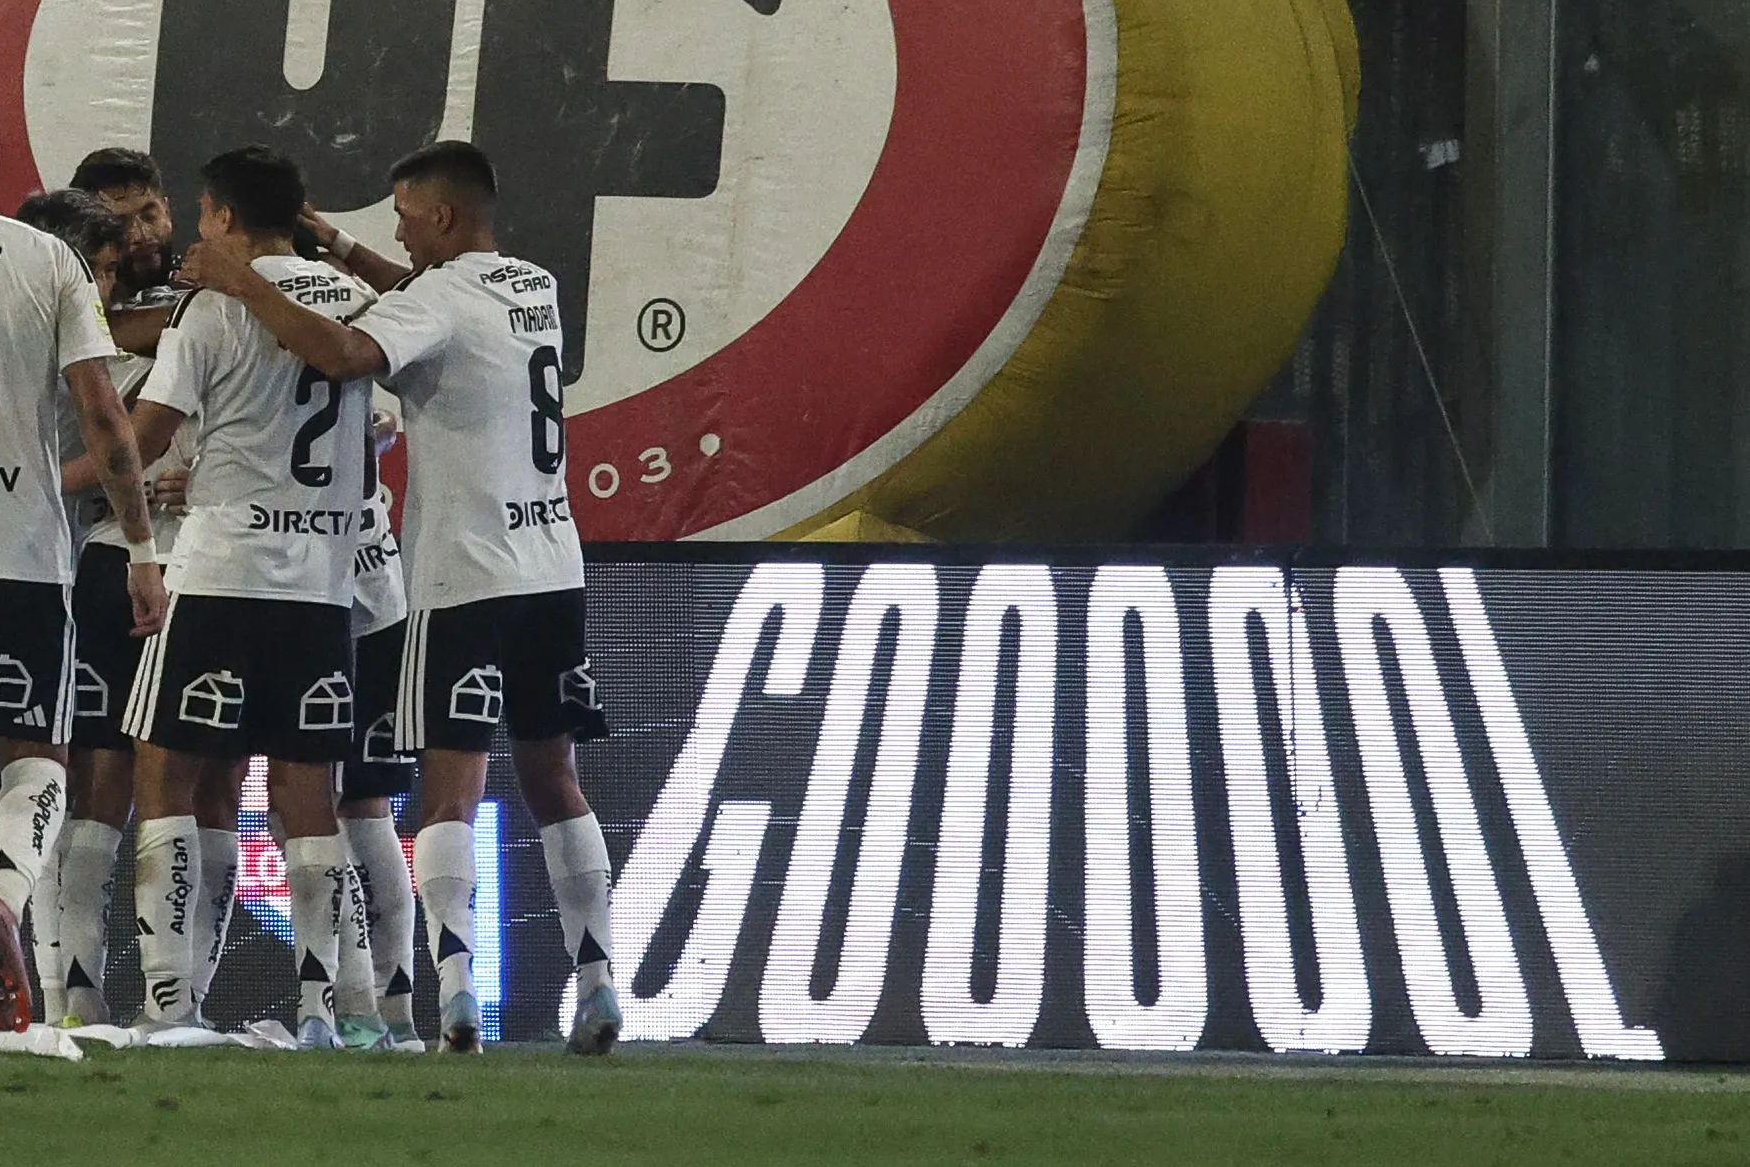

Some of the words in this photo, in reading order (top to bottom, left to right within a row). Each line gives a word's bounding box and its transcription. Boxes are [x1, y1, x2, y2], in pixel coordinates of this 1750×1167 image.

[271, 275, 340, 293] SSIST
[479, 264, 534, 285] ASSIS
[511, 275, 551, 294] CARD
[296, 287, 351, 306] CARD
[528, 345, 564, 475] 8
[291, 364, 341, 487] 2
[505, 496, 569, 531] DIREC
